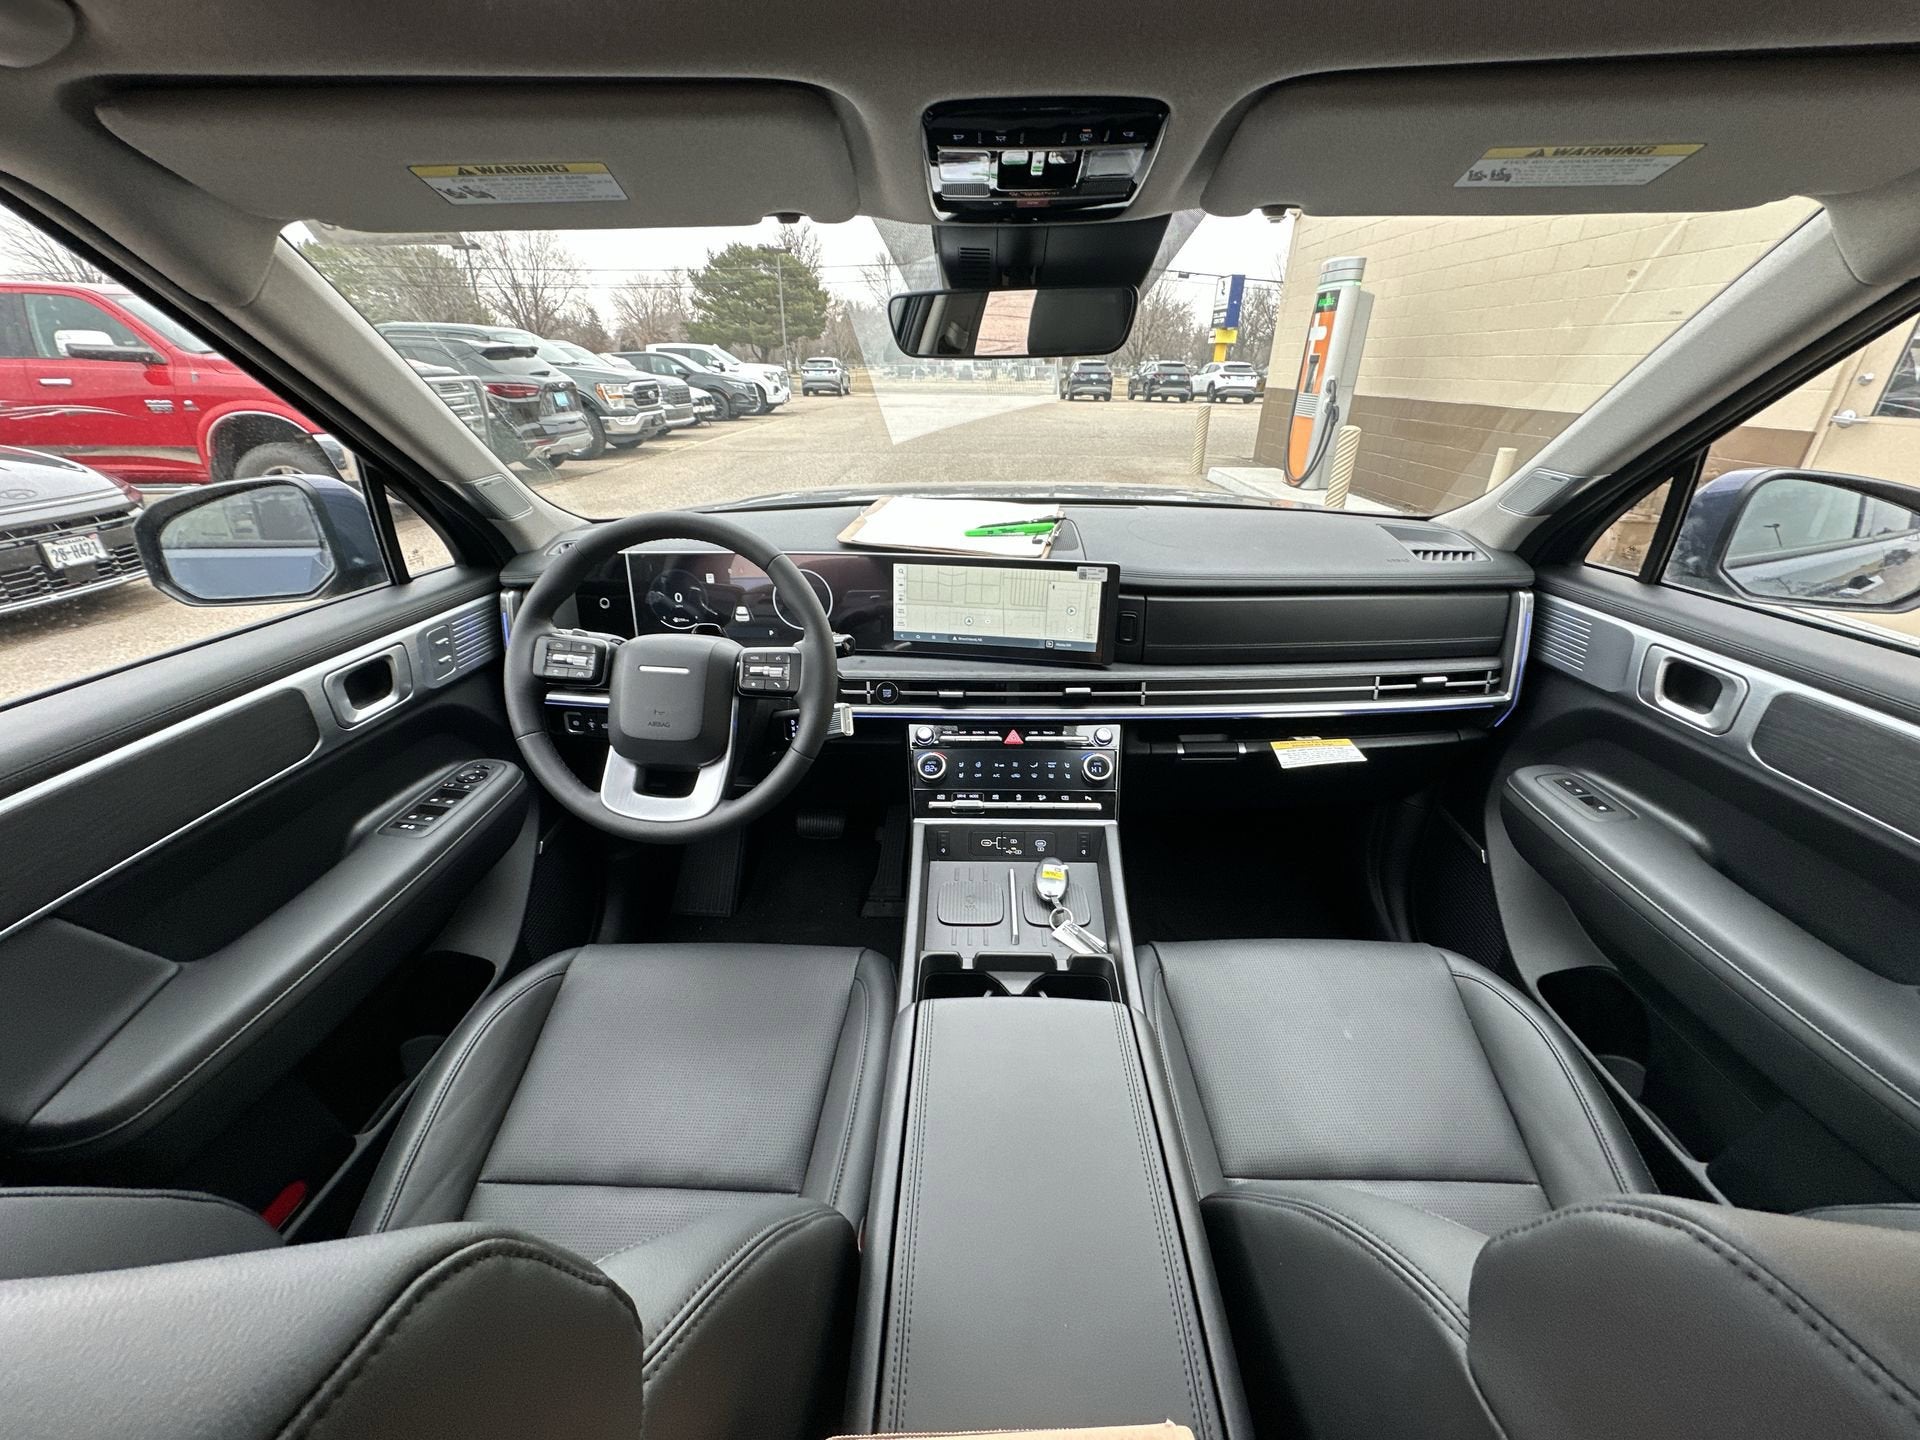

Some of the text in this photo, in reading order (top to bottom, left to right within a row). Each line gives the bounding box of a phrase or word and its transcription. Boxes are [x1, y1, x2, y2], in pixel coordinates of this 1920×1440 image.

[1552, 146, 1658, 156] WARNING
[474, 164, 570, 175] WARNING
[674, 592, 683, 603] 0
